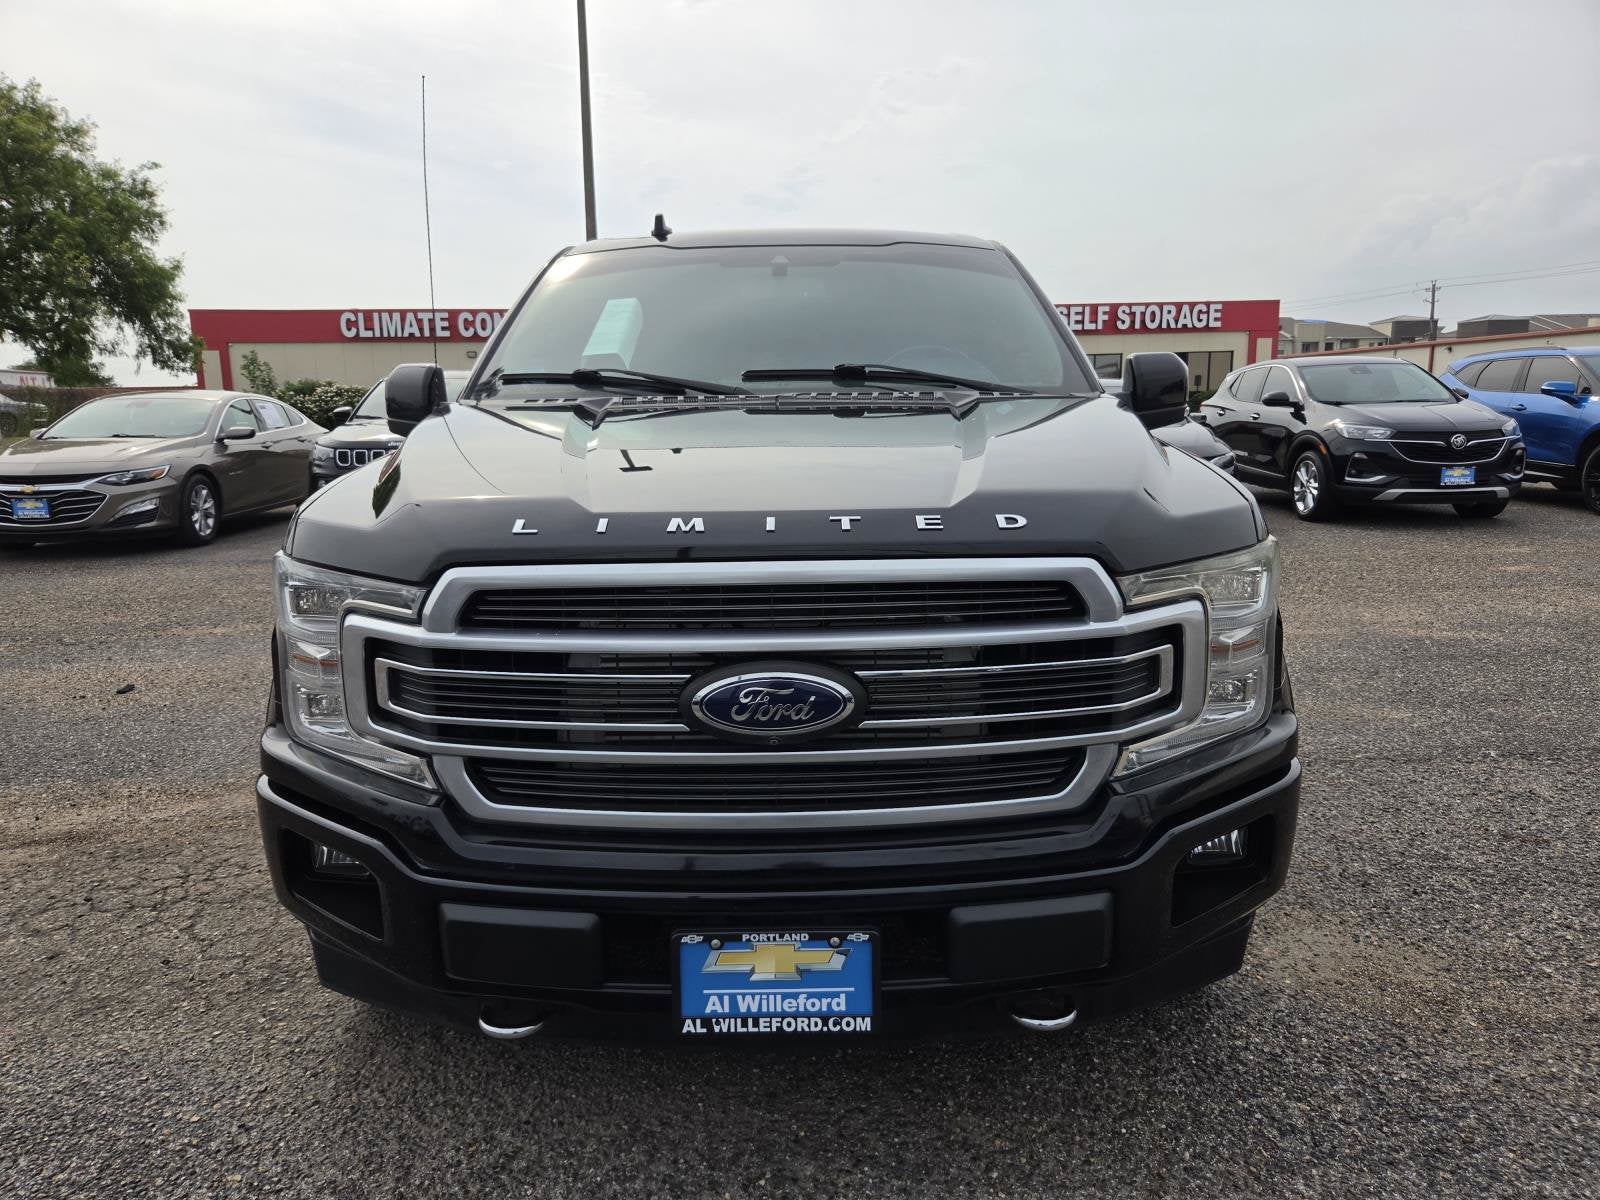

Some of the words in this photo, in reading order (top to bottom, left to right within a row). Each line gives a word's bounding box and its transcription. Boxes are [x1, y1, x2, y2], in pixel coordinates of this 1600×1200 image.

[340, 311, 451, 338] CLIMATE
[1056, 305, 1110, 331] SELF
[1116, 303, 1223, 330] STORAGE
[511, 513, 1028, 534] LIMITED
[730, 687, 816, 722] Ford
[742, 933, 809, 942] PORTLAND
[704, 994, 730, 1014] Al
[737, 993, 847, 1013] Willeford
[682, 1018, 707, 1034] AL
[712, 1016, 872, 1033] WILLEFORD.COM
